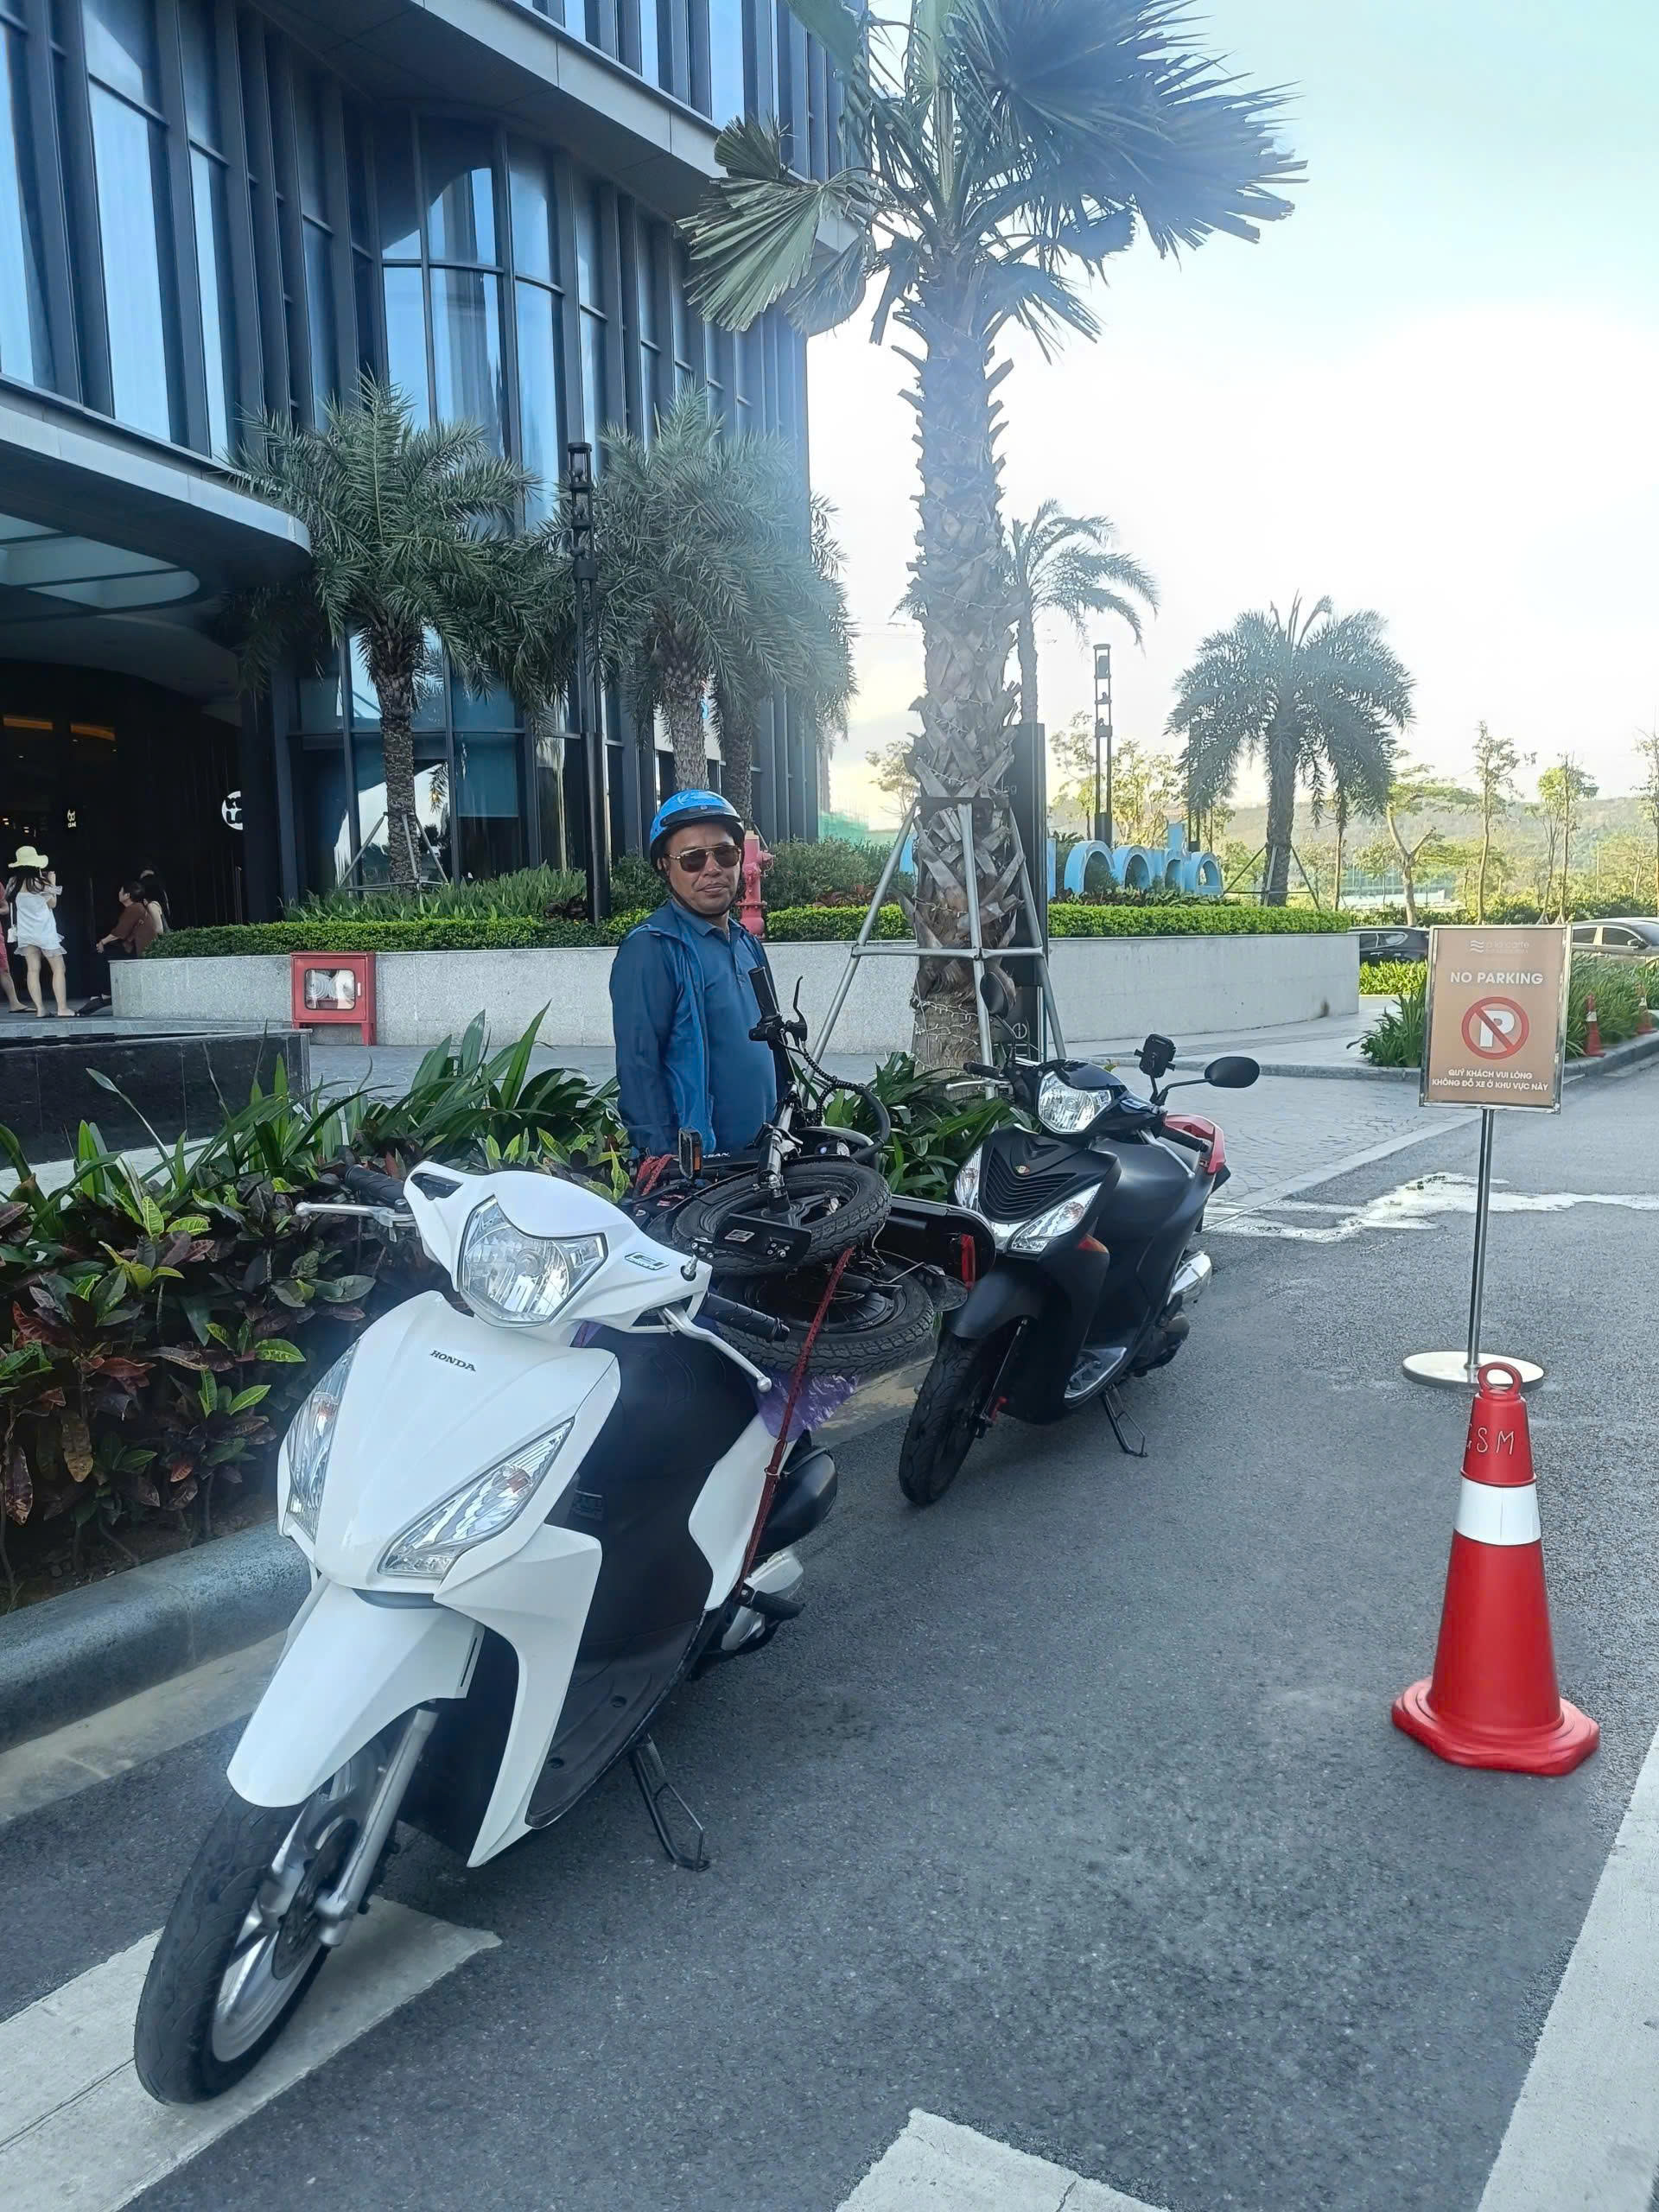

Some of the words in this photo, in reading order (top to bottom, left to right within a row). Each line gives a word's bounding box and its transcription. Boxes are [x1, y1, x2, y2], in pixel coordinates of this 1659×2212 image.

[1450, 971, 1472, 983] NO
[1477, 972, 1544, 985] PARKING
[1448, 1068, 1465, 1077] QUÝ
[1466, 1069, 1494, 1078] KHÁCH
[1432, 1077, 1460, 1086] KHÔNG
[430, 1350, 476, 1372] HONDA
